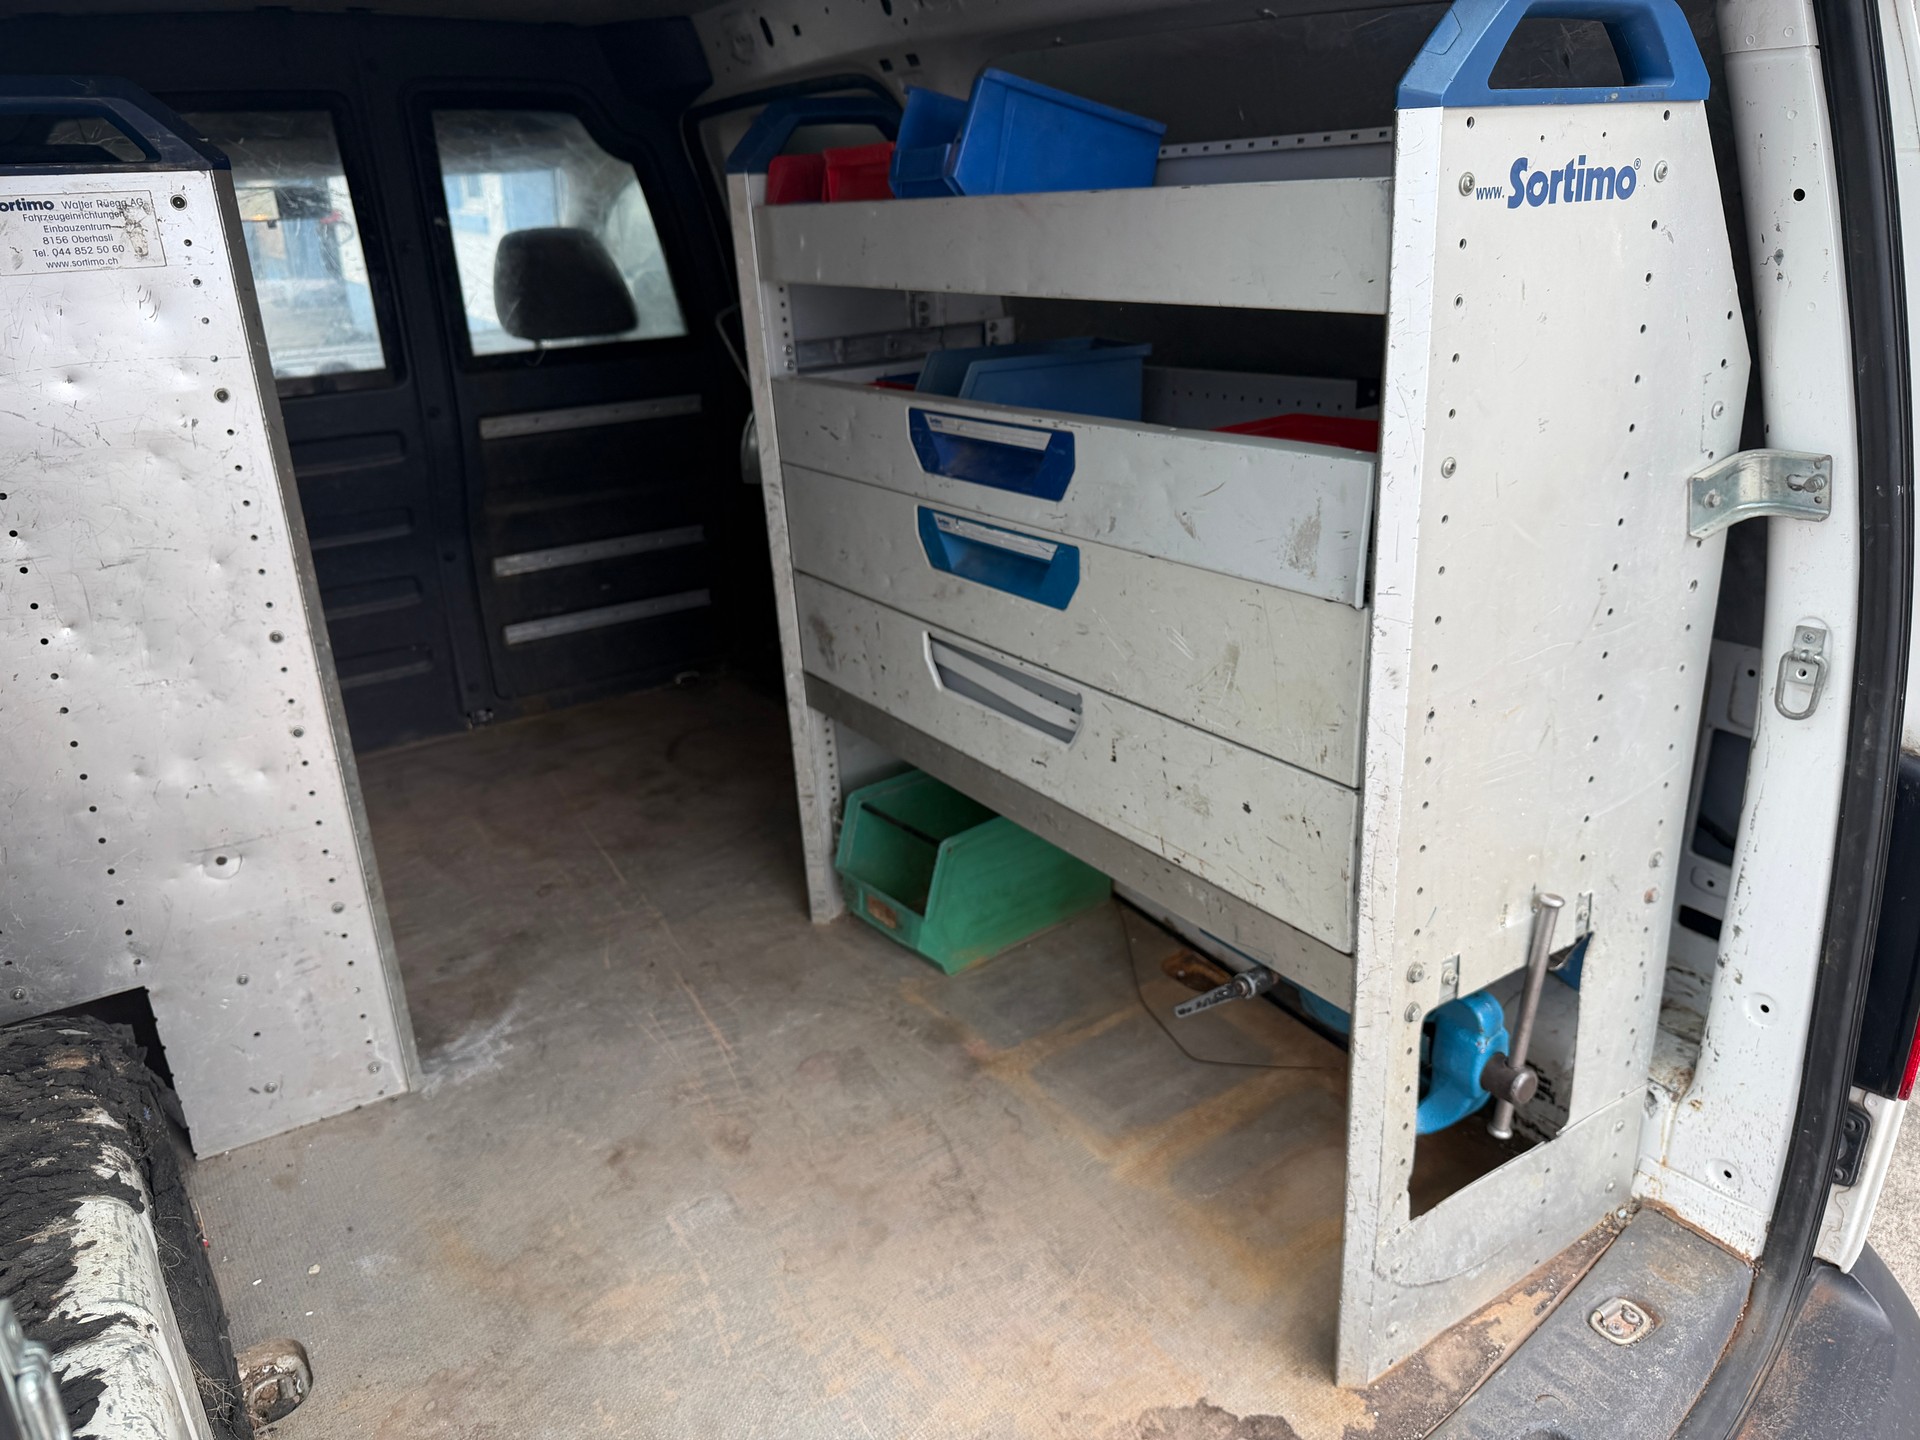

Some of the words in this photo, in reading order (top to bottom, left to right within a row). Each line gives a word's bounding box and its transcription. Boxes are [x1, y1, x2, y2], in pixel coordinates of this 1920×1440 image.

[1475, 186, 1505, 200] www.
[0, 198, 55, 212] ortimo
[61, 200, 93, 210] Walter
[96, 199, 127, 210] Rüegg
[130, 197, 144, 207] AG
[22, 210, 125, 222] Fahrzeugeinrichtungen
[43, 223, 111, 234] Einbauzentrum
[42, 235, 69, 245] 8156
[71, 234, 114, 244] Oberhasli
[33, 249, 49, 257] Tel.
[52, 247, 71, 257] 044
[74, 246, 94, 255] 852
[96, 245, 110, 254] 50
[112, 244, 125, 253] 60
[45, 257, 119, 269] www.sortimo.ch
